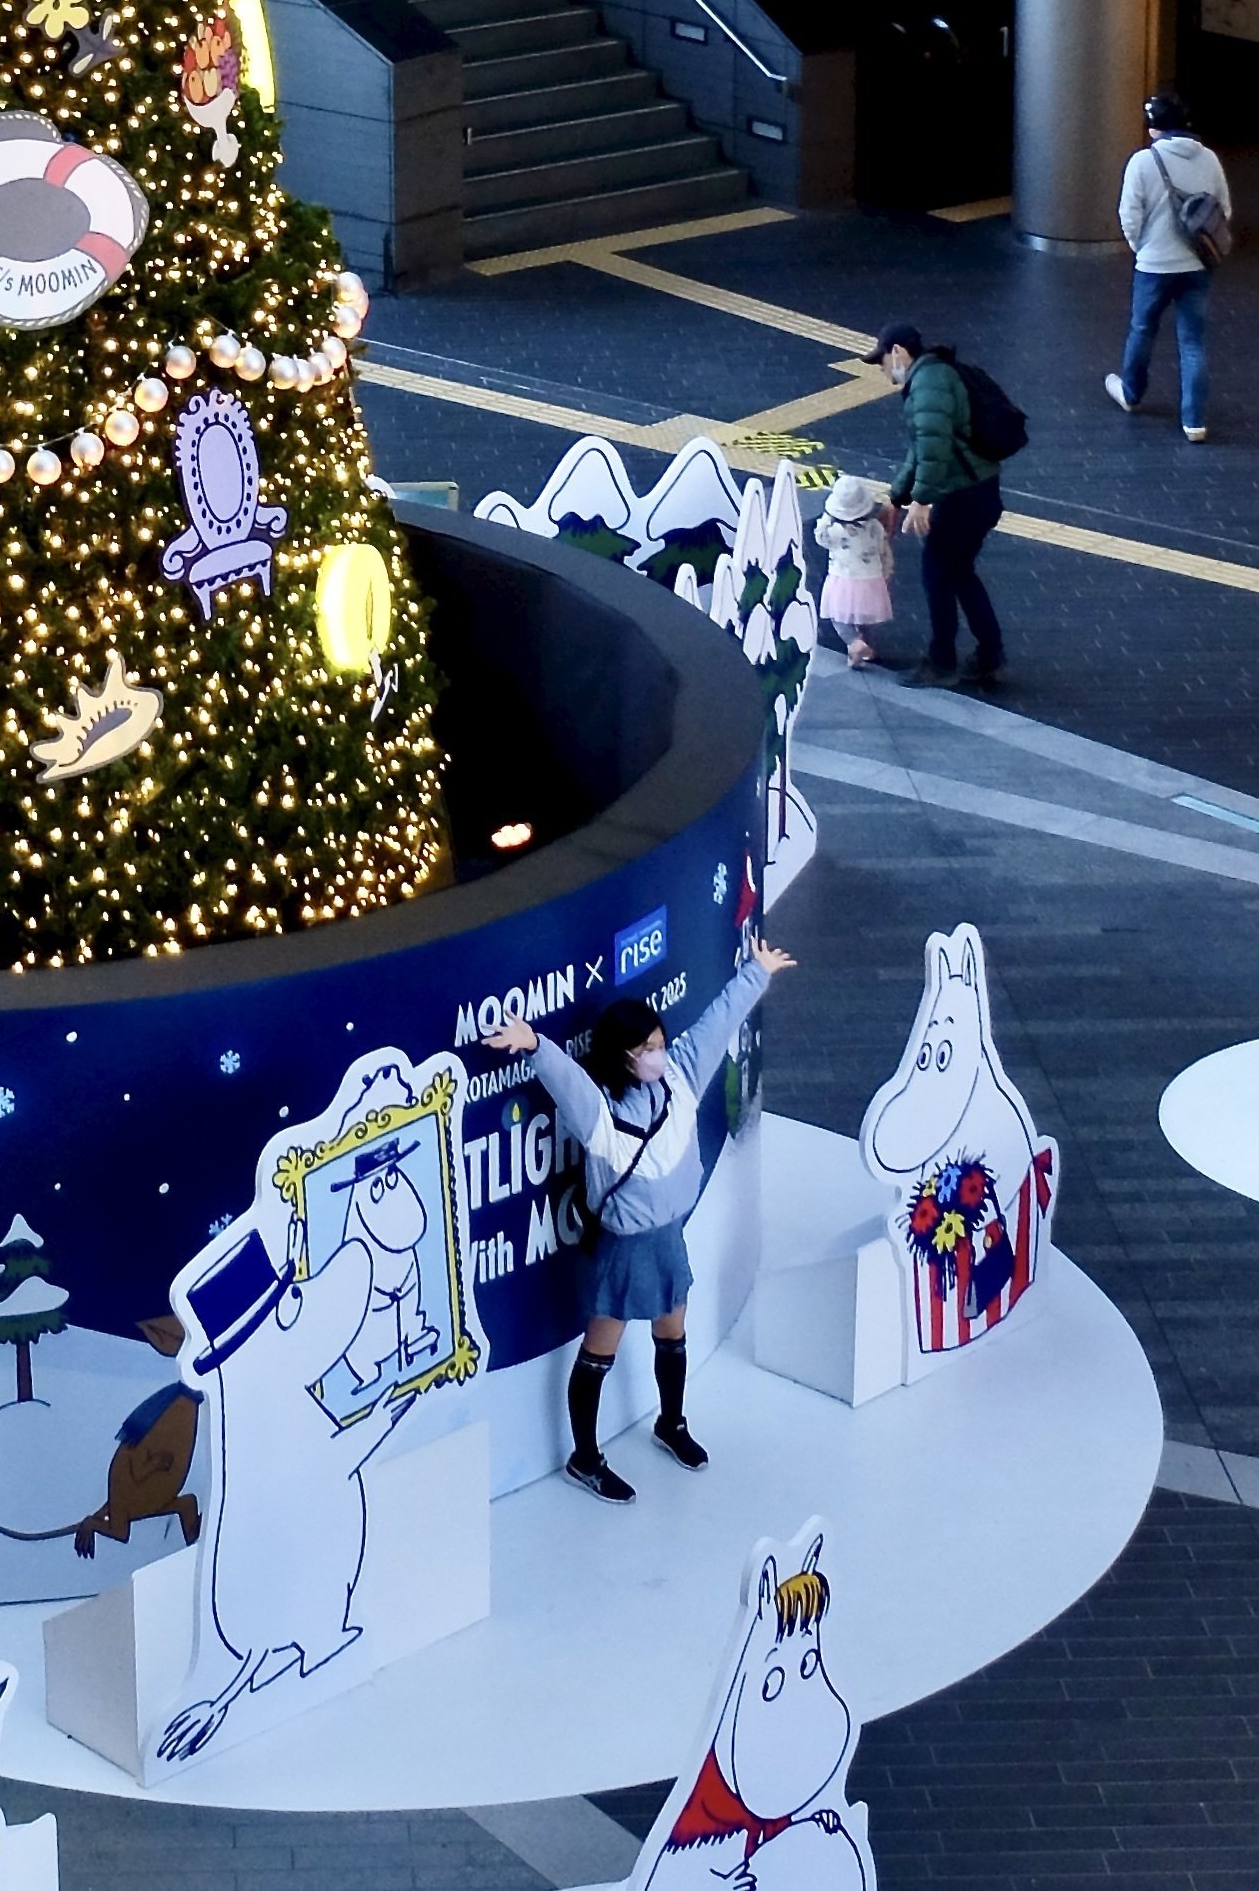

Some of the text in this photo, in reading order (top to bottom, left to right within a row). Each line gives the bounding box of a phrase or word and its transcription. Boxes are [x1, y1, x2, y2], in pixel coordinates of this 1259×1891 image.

[18, 259, 97, 297] MOOMIN
[454, 964, 575, 1048] MOOMIN
[621, 929, 663, 974] rise
[661, 972, 687, 1011] 2025
